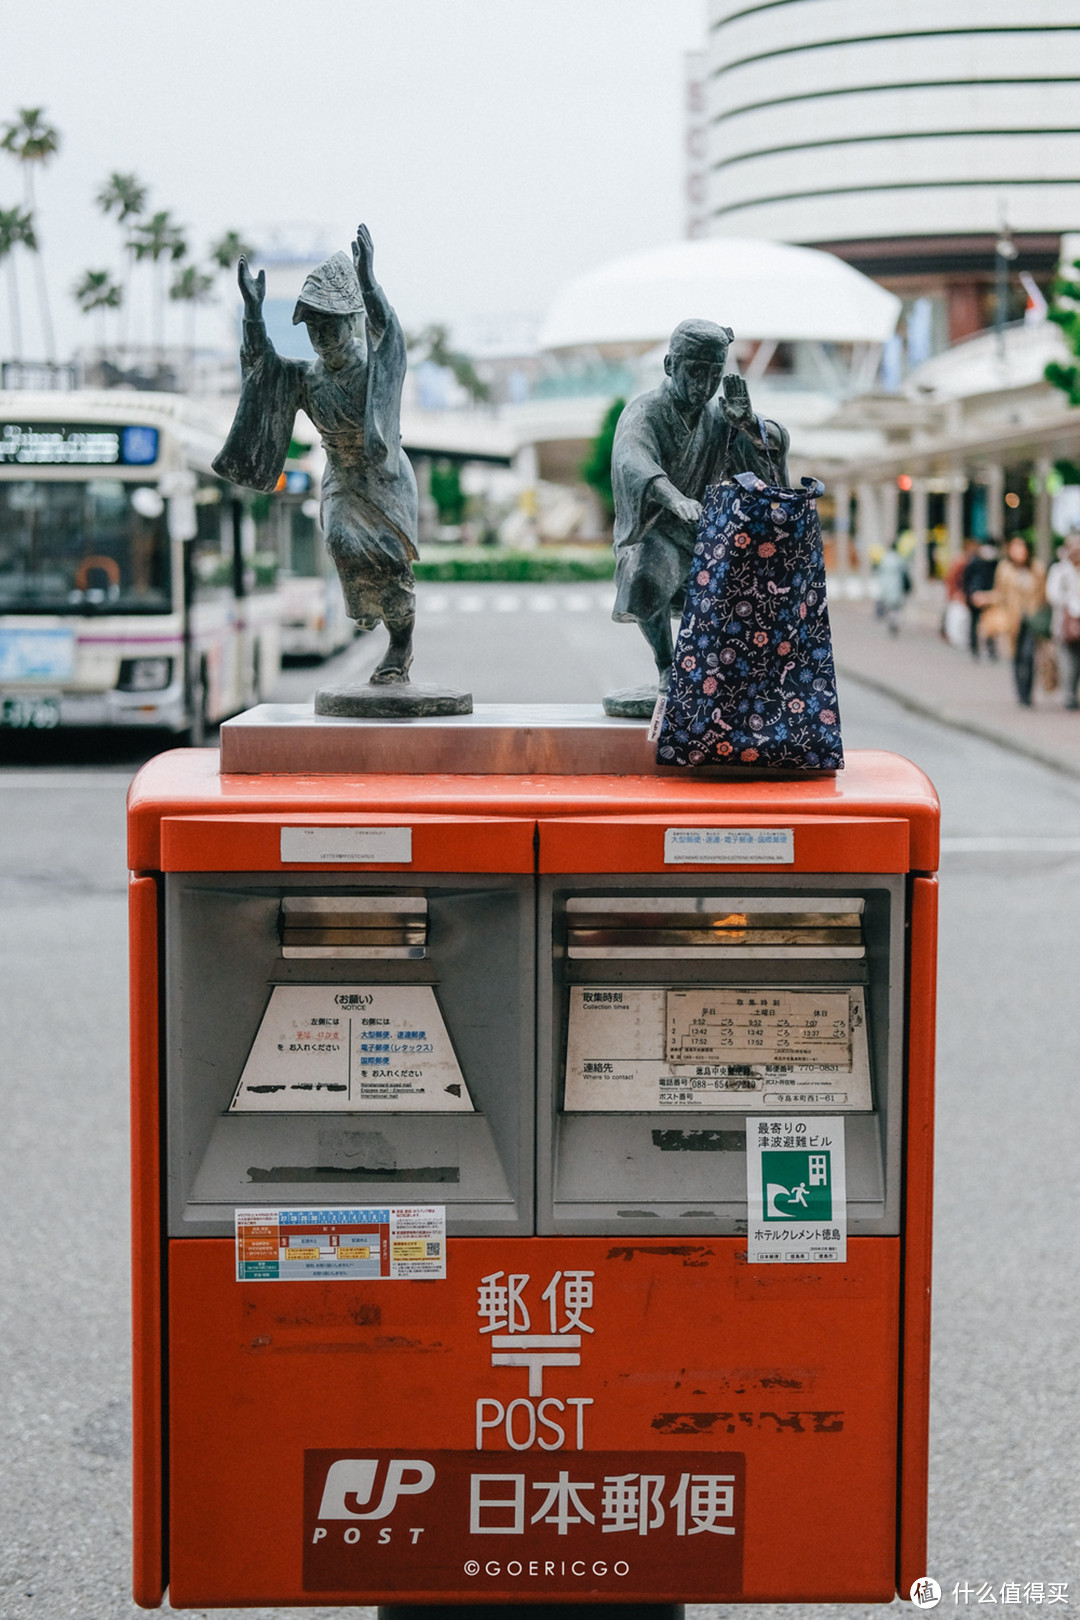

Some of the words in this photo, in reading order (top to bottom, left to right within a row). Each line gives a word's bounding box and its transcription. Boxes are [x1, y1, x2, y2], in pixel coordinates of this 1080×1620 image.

[583, 992, 622, 1002] 取集時刻
[583, 1062, 614, 1073] 連絡先
[758, 1122, 807, 1134] 最寄りの
[758, 1135, 832, 1148] 津波避難ビル
[754, 1228, 841, 1241] ホテルクレメント徳島
[476, 1270, 594, 1334] 郵便
[476, 1397, 594, 1450] POST
[317, 1459, 436, 1520] JP
[469, 1470, 736, 1536] 日本郵便
[312, 1527, 424, 1544] POST
